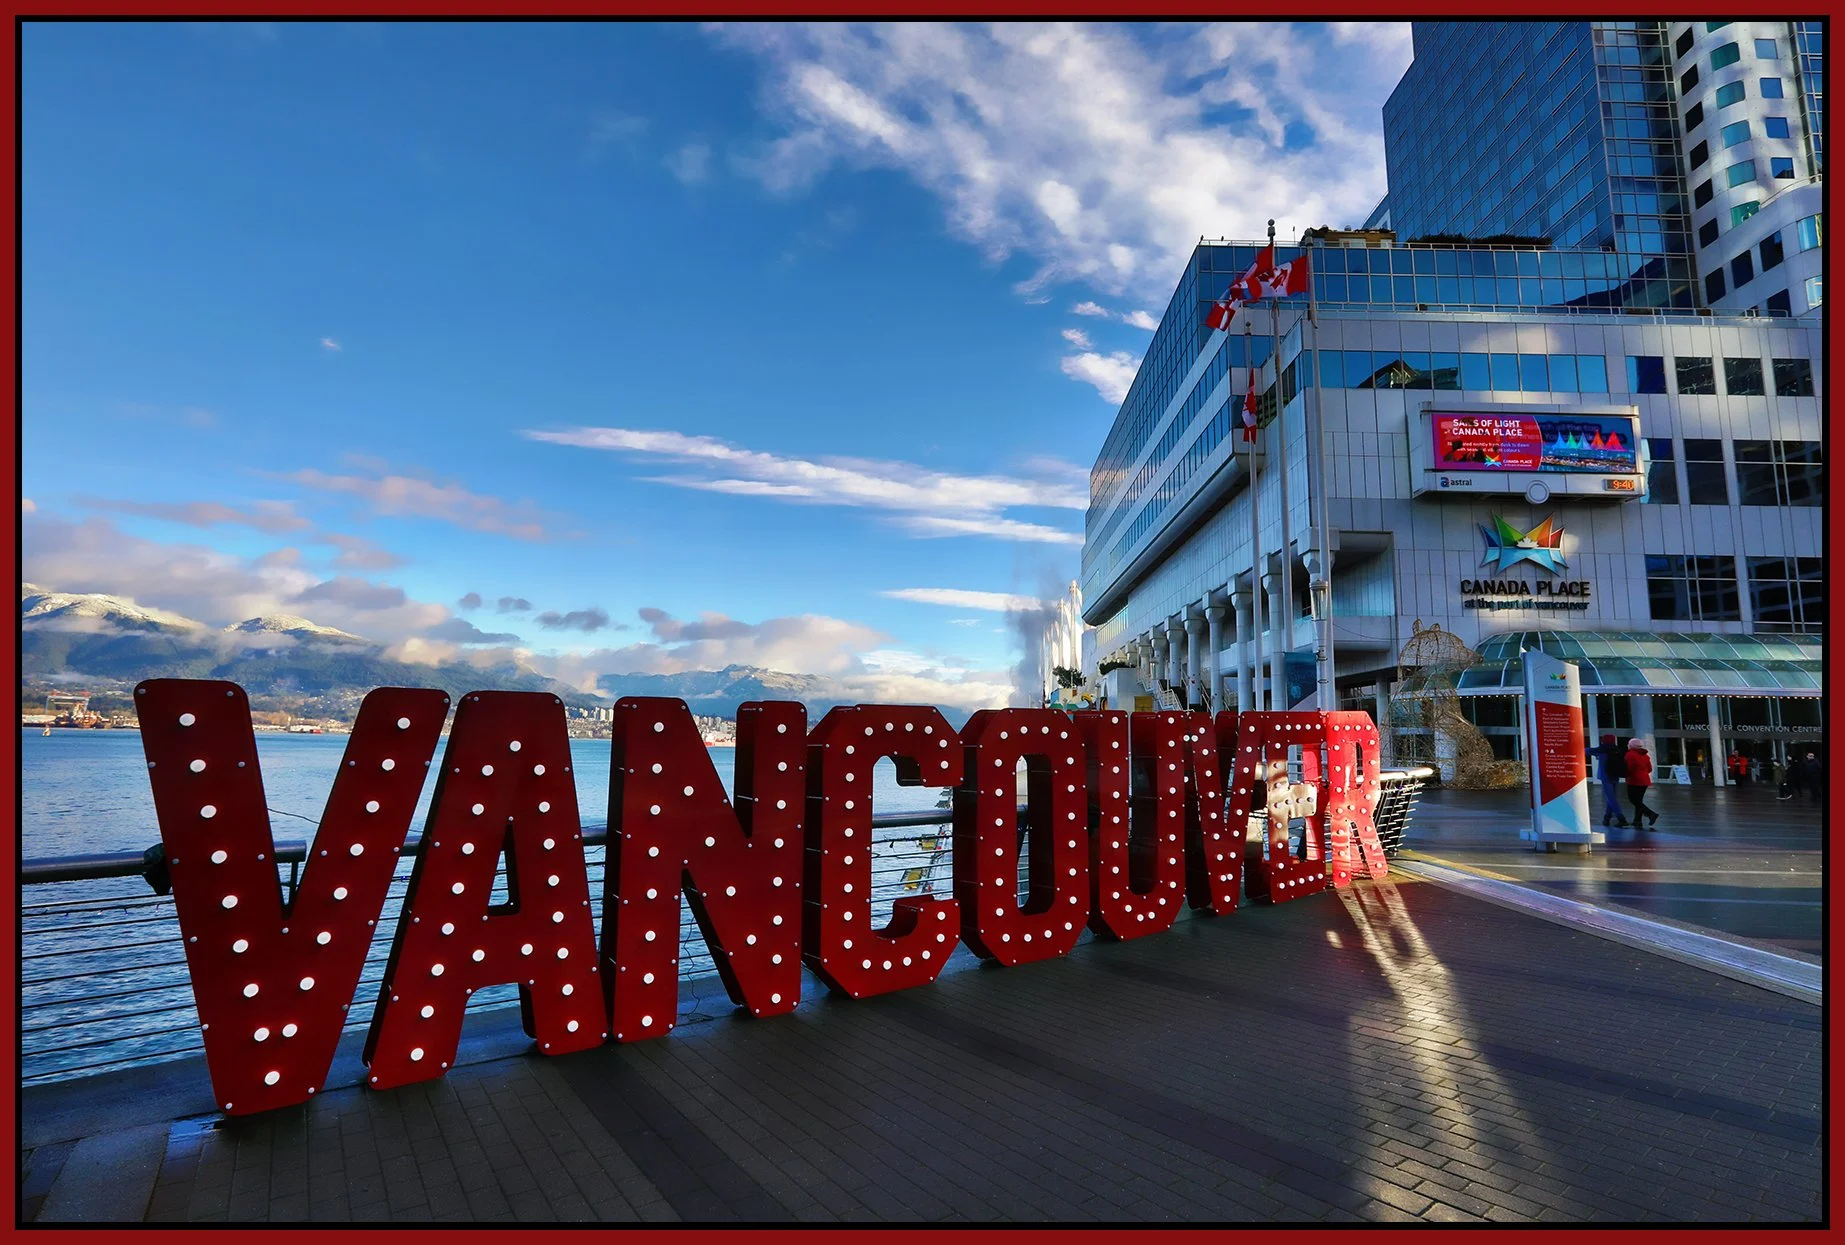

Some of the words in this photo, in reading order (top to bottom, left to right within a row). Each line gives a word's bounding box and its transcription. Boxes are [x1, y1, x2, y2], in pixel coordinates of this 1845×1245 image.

[1495, 420, 1520, 428] LIGHT
[1452, 428, 1490, 436] CANADA
[1450, 478, 1472, 486] astral
[1612, 480, 1635, 490] 9:40
[1460, 579, 1531, 596] CANADA
[1536, 580, 1591, 597] PLACE
[1464, 599, 1475, 609] at
[1476, 598, 1494, 609] the
[1497, 599, 1519, 611] port
[1522, 598, 1533, 610] of
[1534, 601, 1590, 611] vancouver
[1737, 725, 1790, 733] CONVENTION
[134, 677, 1389, 1116] VANCOUVER
